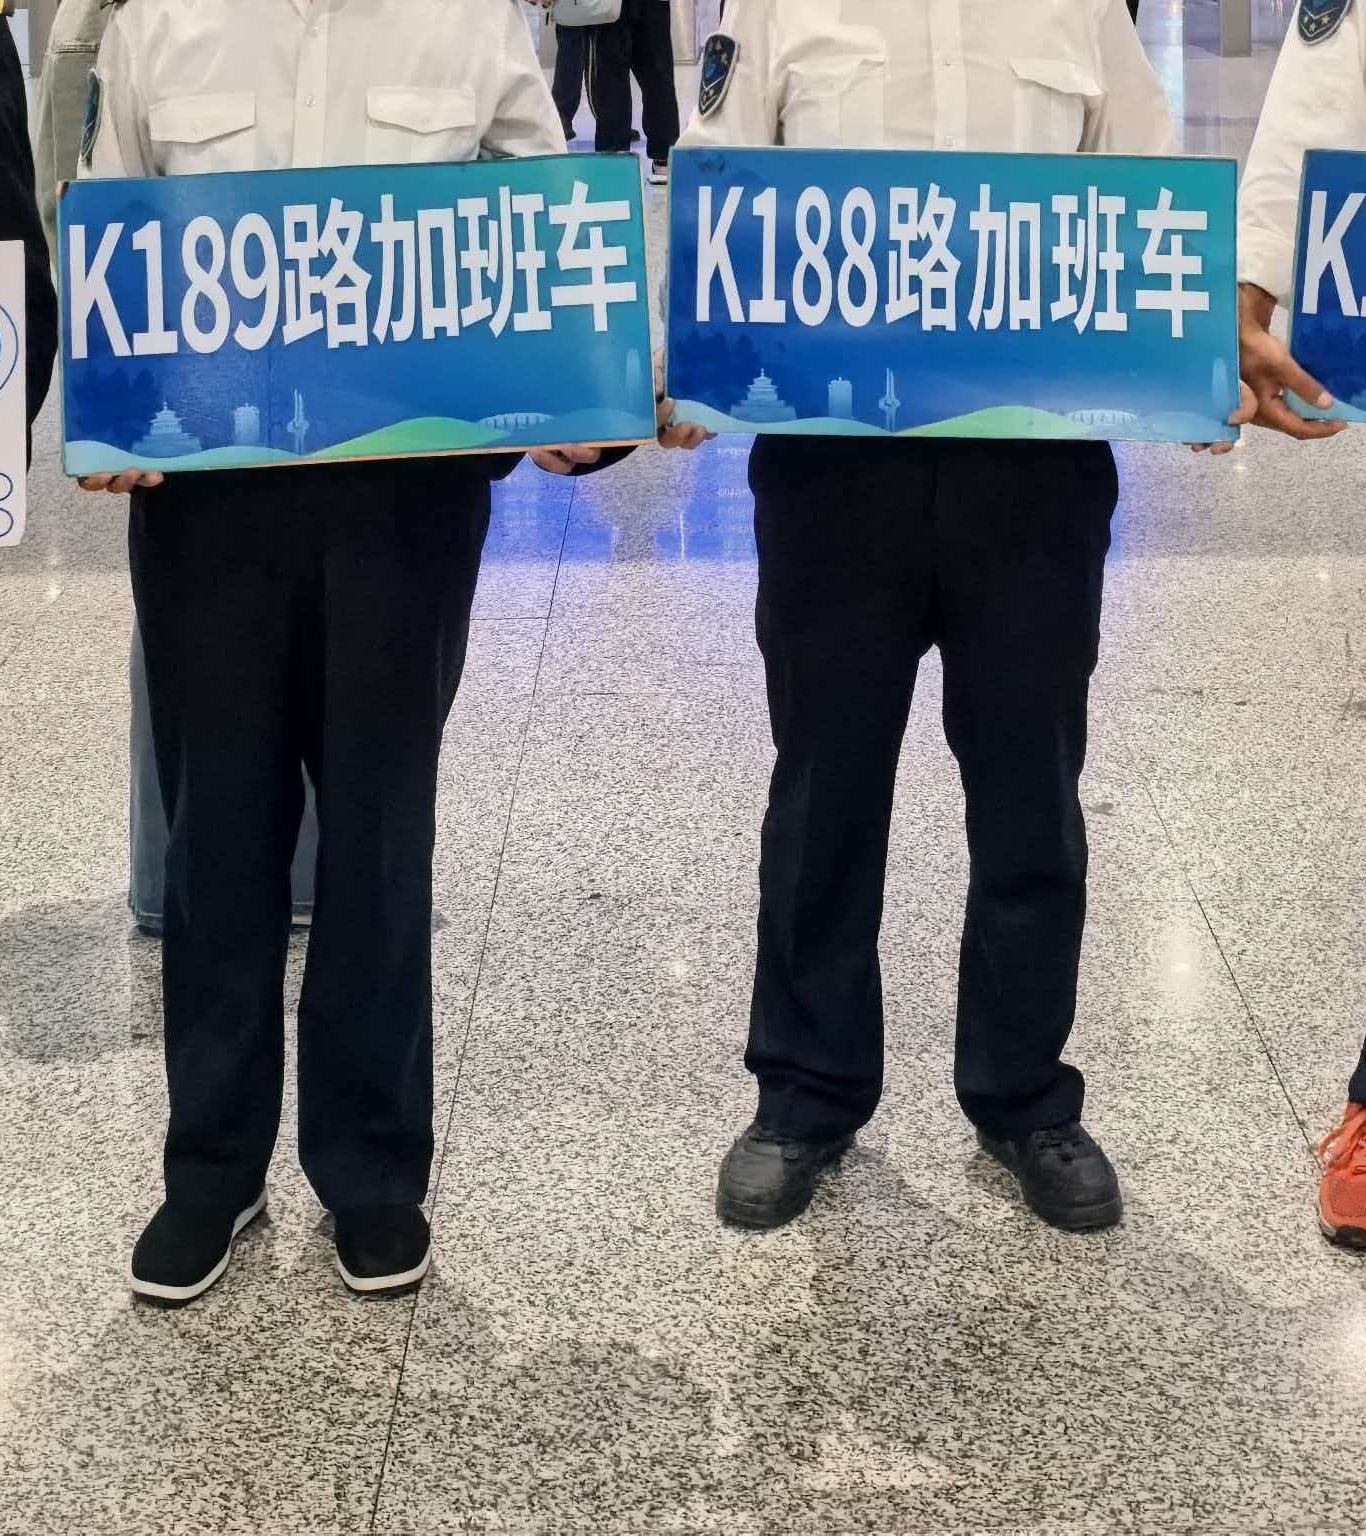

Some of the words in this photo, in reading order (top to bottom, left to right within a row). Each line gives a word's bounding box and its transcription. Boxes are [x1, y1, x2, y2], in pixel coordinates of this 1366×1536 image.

[68, 181, 638, 360] K189路加班车
[695, 182, 1210, 339] K188路加班车
